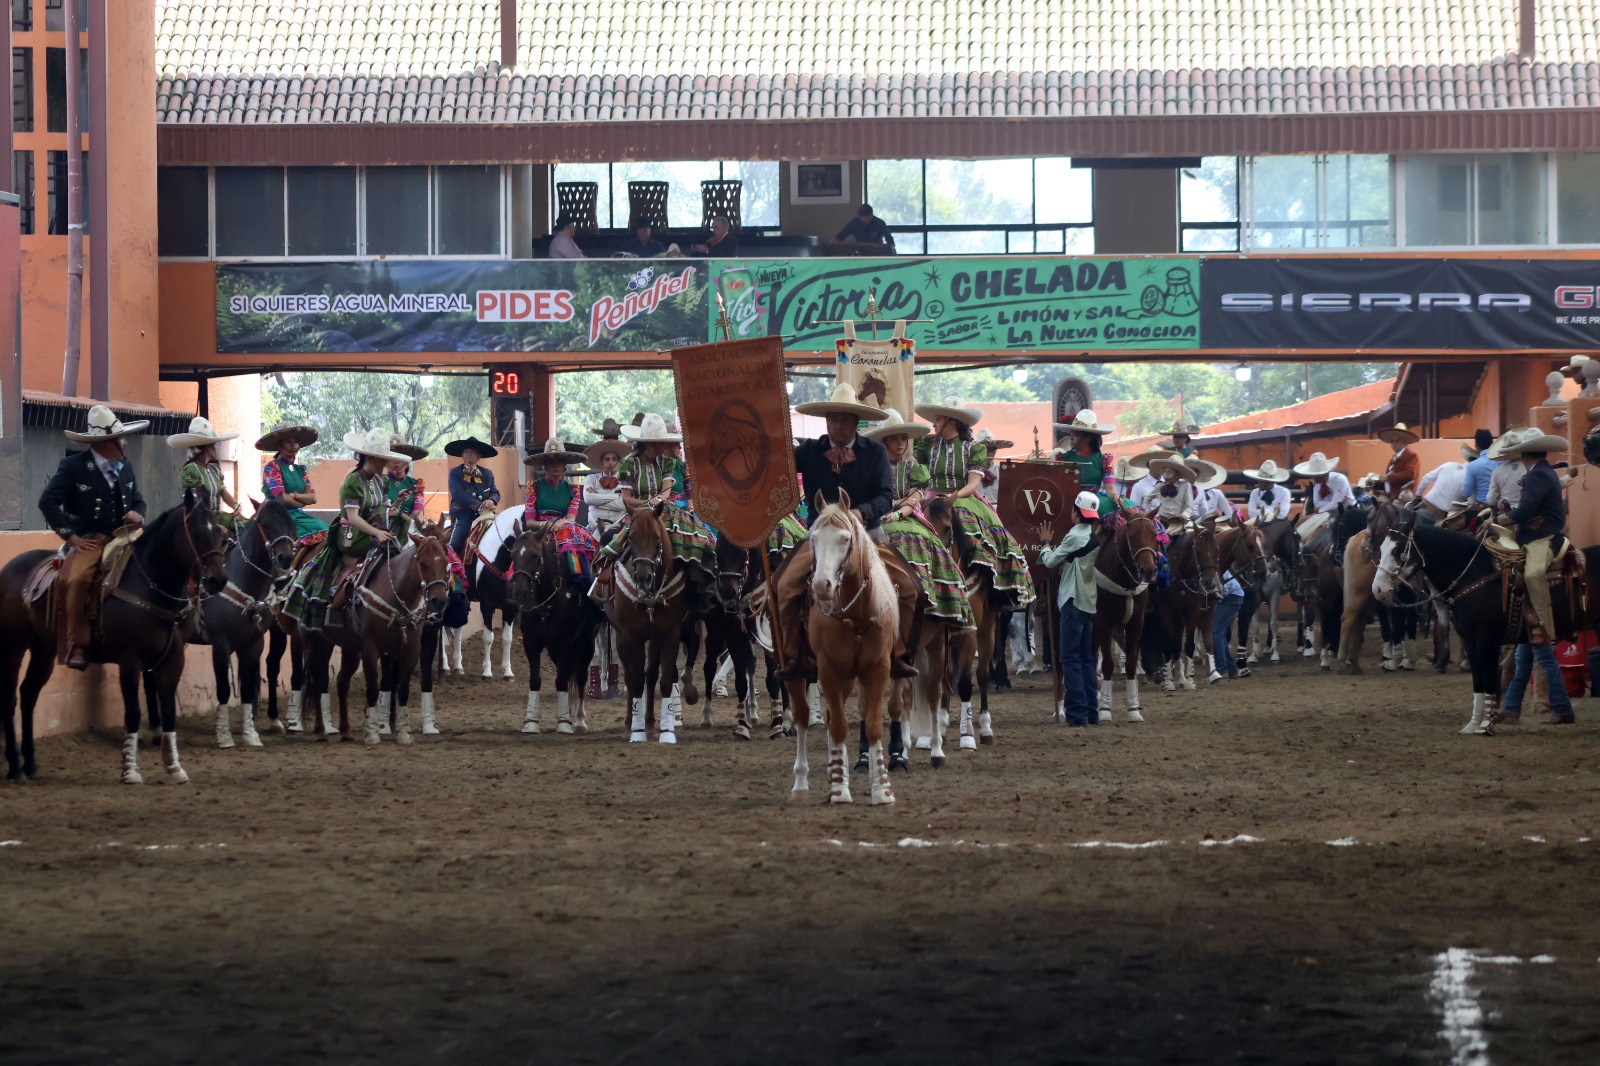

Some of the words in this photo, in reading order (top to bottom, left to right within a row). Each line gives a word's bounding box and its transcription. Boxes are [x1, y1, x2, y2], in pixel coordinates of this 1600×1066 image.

[760, 267, 787, 283] NUEVA
[950, 261, 1127, 303] CHELADA
[232, 297, 247, 312] SI
[252, 297, 328, 312] QUIERES
[333, 296, 385, 311] AGUA
[390, 295, 471, 311] MINERAL
[478, 292, 572, 320] PIDES
[589, 266, 695, 347] Peñafiel
[757, 262, 923, 340] Victoria
[1221, 293, 1532, 313] SIERRA
[1554, 285, 1600, 308] G
[997, 305, 1069, 326] LIMÓN
[1085, 305, 1128, 322] SAL
[1555, 316, 1569, 324] WE
[1570, 316, 1588, 324] ARE
[937, 321, 979, 340] SABOR
[685, 363, 752, 382] NACIONAL
[757, 359, 775, 373] DE
[493, 372, 518, 394] 20
[687, 380, 750, 400] CHARROS
[1021, 489, 1055, 516] VR
